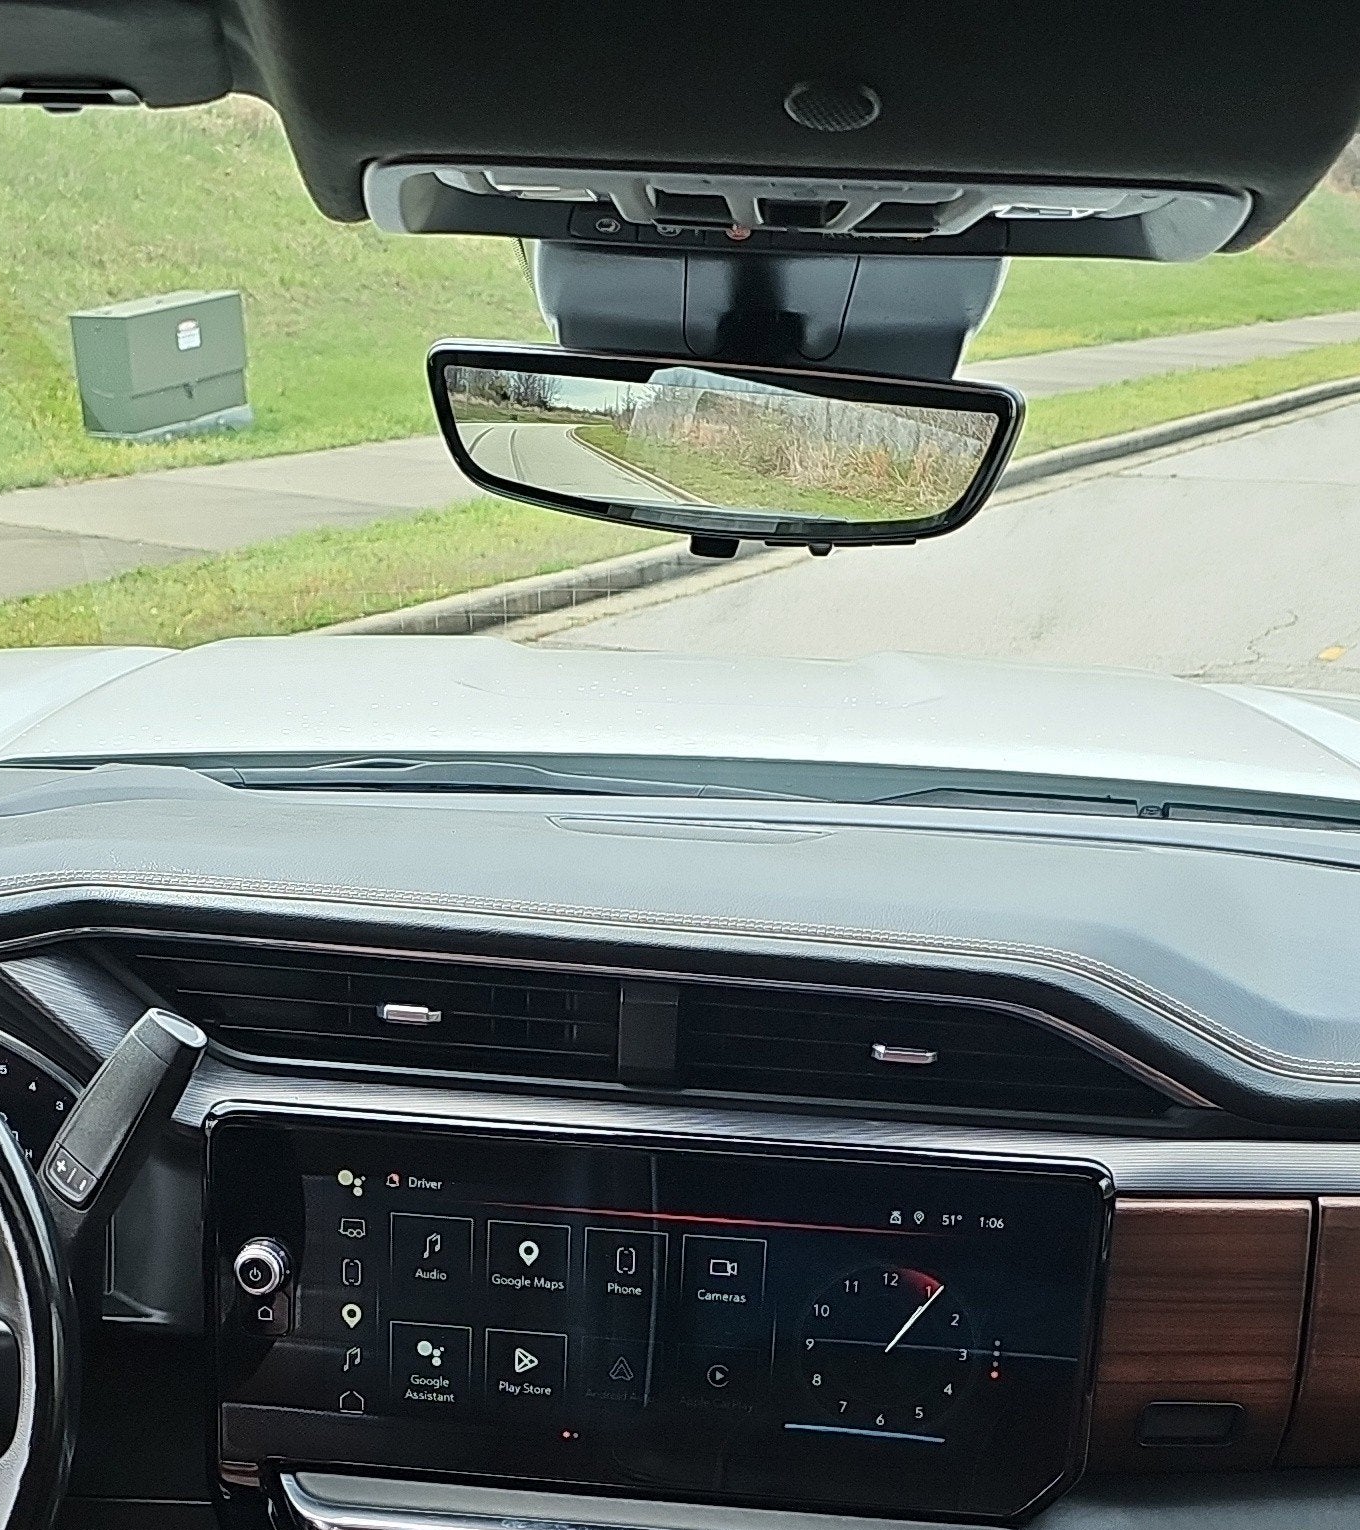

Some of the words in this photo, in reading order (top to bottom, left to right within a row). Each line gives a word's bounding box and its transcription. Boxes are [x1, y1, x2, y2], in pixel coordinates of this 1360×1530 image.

[0, 1064, 8, 1075] 5
[28, 1081, 37, 1092] 4
[55, 1100, 64, 1111] 3
[407, 1175, 443, 1191] Driver
[941, 1214, 963, 1226] 51°
[979, 1216, 1005, 1229] 1:06
[414, 1267, 448, 1281] Audio
[882, 1272, 899, 1287] 12
[491, 1273, 532, 1289] Google
[533, 1276, 565, 1292] Maps
[607, 1281, 643, 1297] Phone
[843, 1279, 860, 1293] 11
[697, 1289, 747, 1304] Cameras
[925, 1285, 932, 1298] 1
[812, 1303, 831, 1318] 10
[950, 1313, 960, 1326] 2
[805, 1338, 815, 1351] 9
[958, 1349, 968, 1361] 3
[410, 1373, 450, 1389] Google
[811, 1373, 822, 1387] 8
[404, 1388, 455, 1403] Assistant
[498, 1380, 522, 1396] Play
[523, 1383, 552, 1397] Store
[943, 1383, 953, 1396] 4
[838, 1401, 848, 1413] 7
[914, 1406, 924, 1419] 5
[875, 1413, 885, 1426] 6
